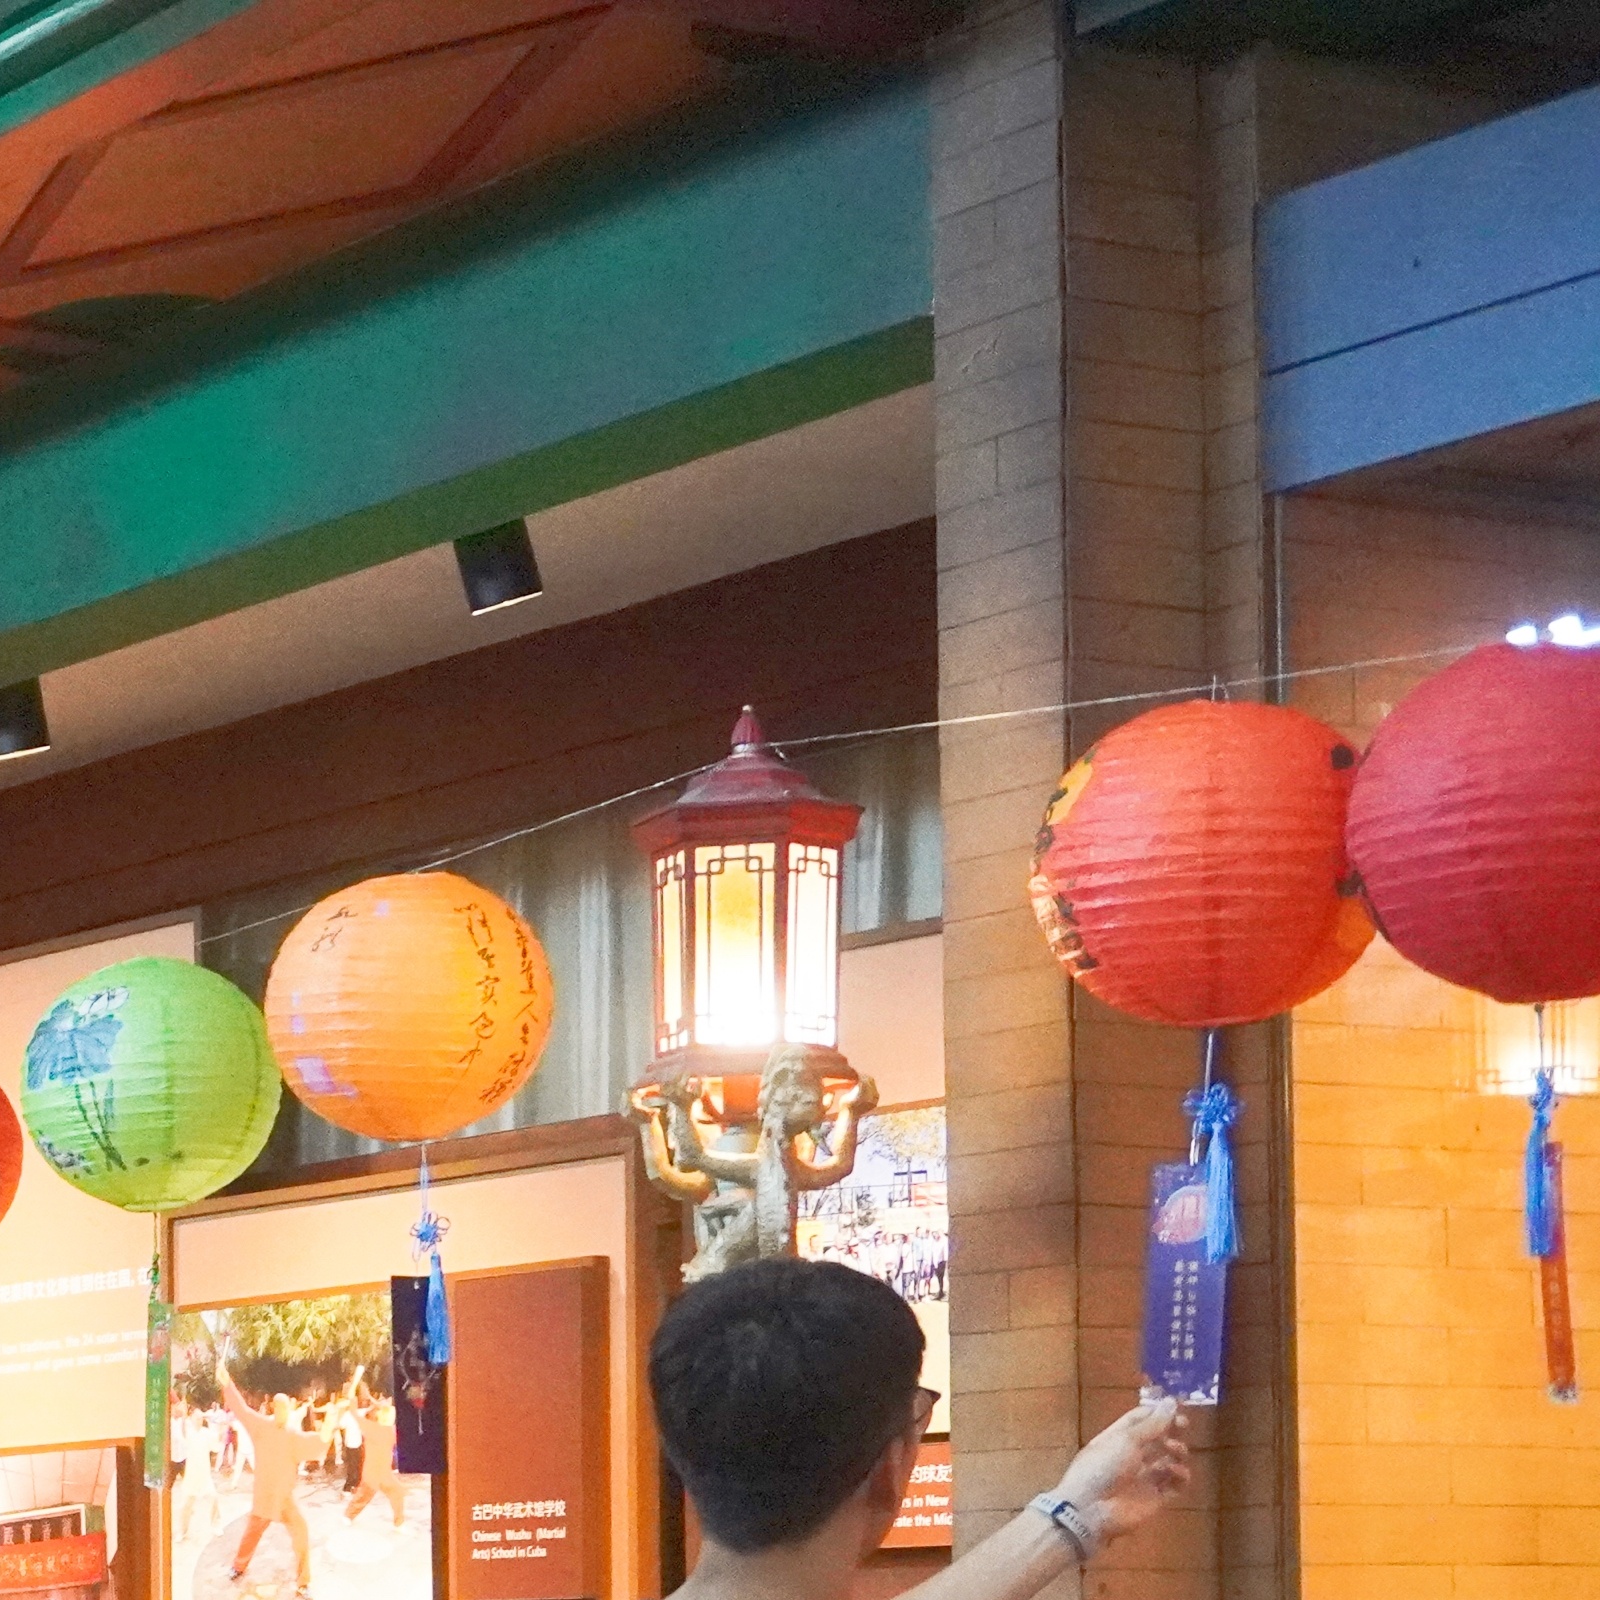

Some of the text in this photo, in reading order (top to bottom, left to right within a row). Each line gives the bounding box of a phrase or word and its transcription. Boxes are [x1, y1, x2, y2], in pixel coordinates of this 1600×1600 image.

[913, 1495, 923, 1507] in
[926, 1494, 949, 1506] New
[914, 1514, 931, 1526] the
[472, 1530, 501, 1542] Chinese
[505, 1529, 532, 1541] Wushu
[491, 1546, 516, 1559] School
[518, 1547, 525, 1558] in
[527, 1545, 547, 1557] Cuba
